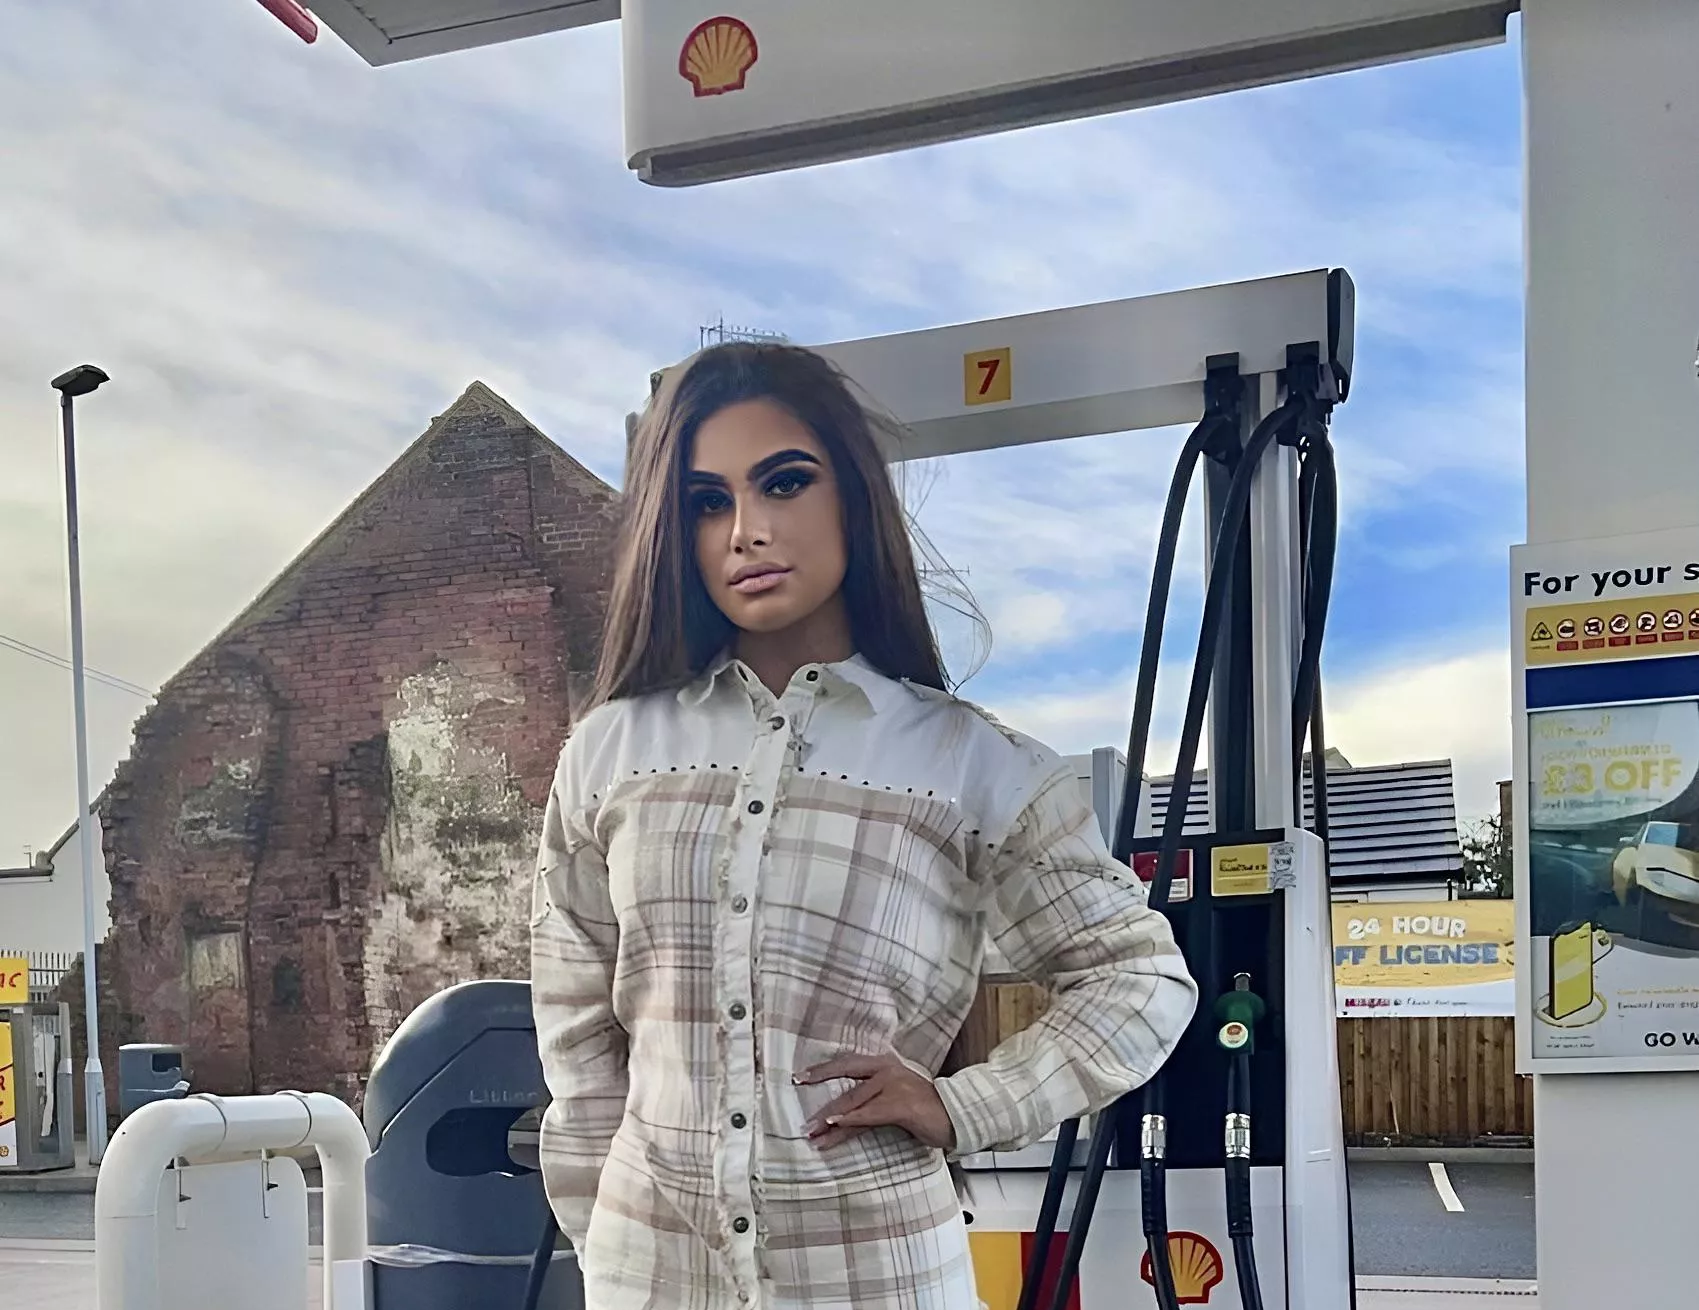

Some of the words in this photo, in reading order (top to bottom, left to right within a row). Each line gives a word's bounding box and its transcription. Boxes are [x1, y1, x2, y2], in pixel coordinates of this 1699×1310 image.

[977, 359, 1000, 395] 7
[1524, 572, 1579, 596] For
[1591, 565, 1671, 597] your
[1604, 759, 1682, 790] OFF
[1347, 918, 1381, 940] 24
[1392, 916, 1466, 938] HOUR
[1379, 943, 1499, 966] LICENSE
[1644, 1032, 1676, 1047] GO
